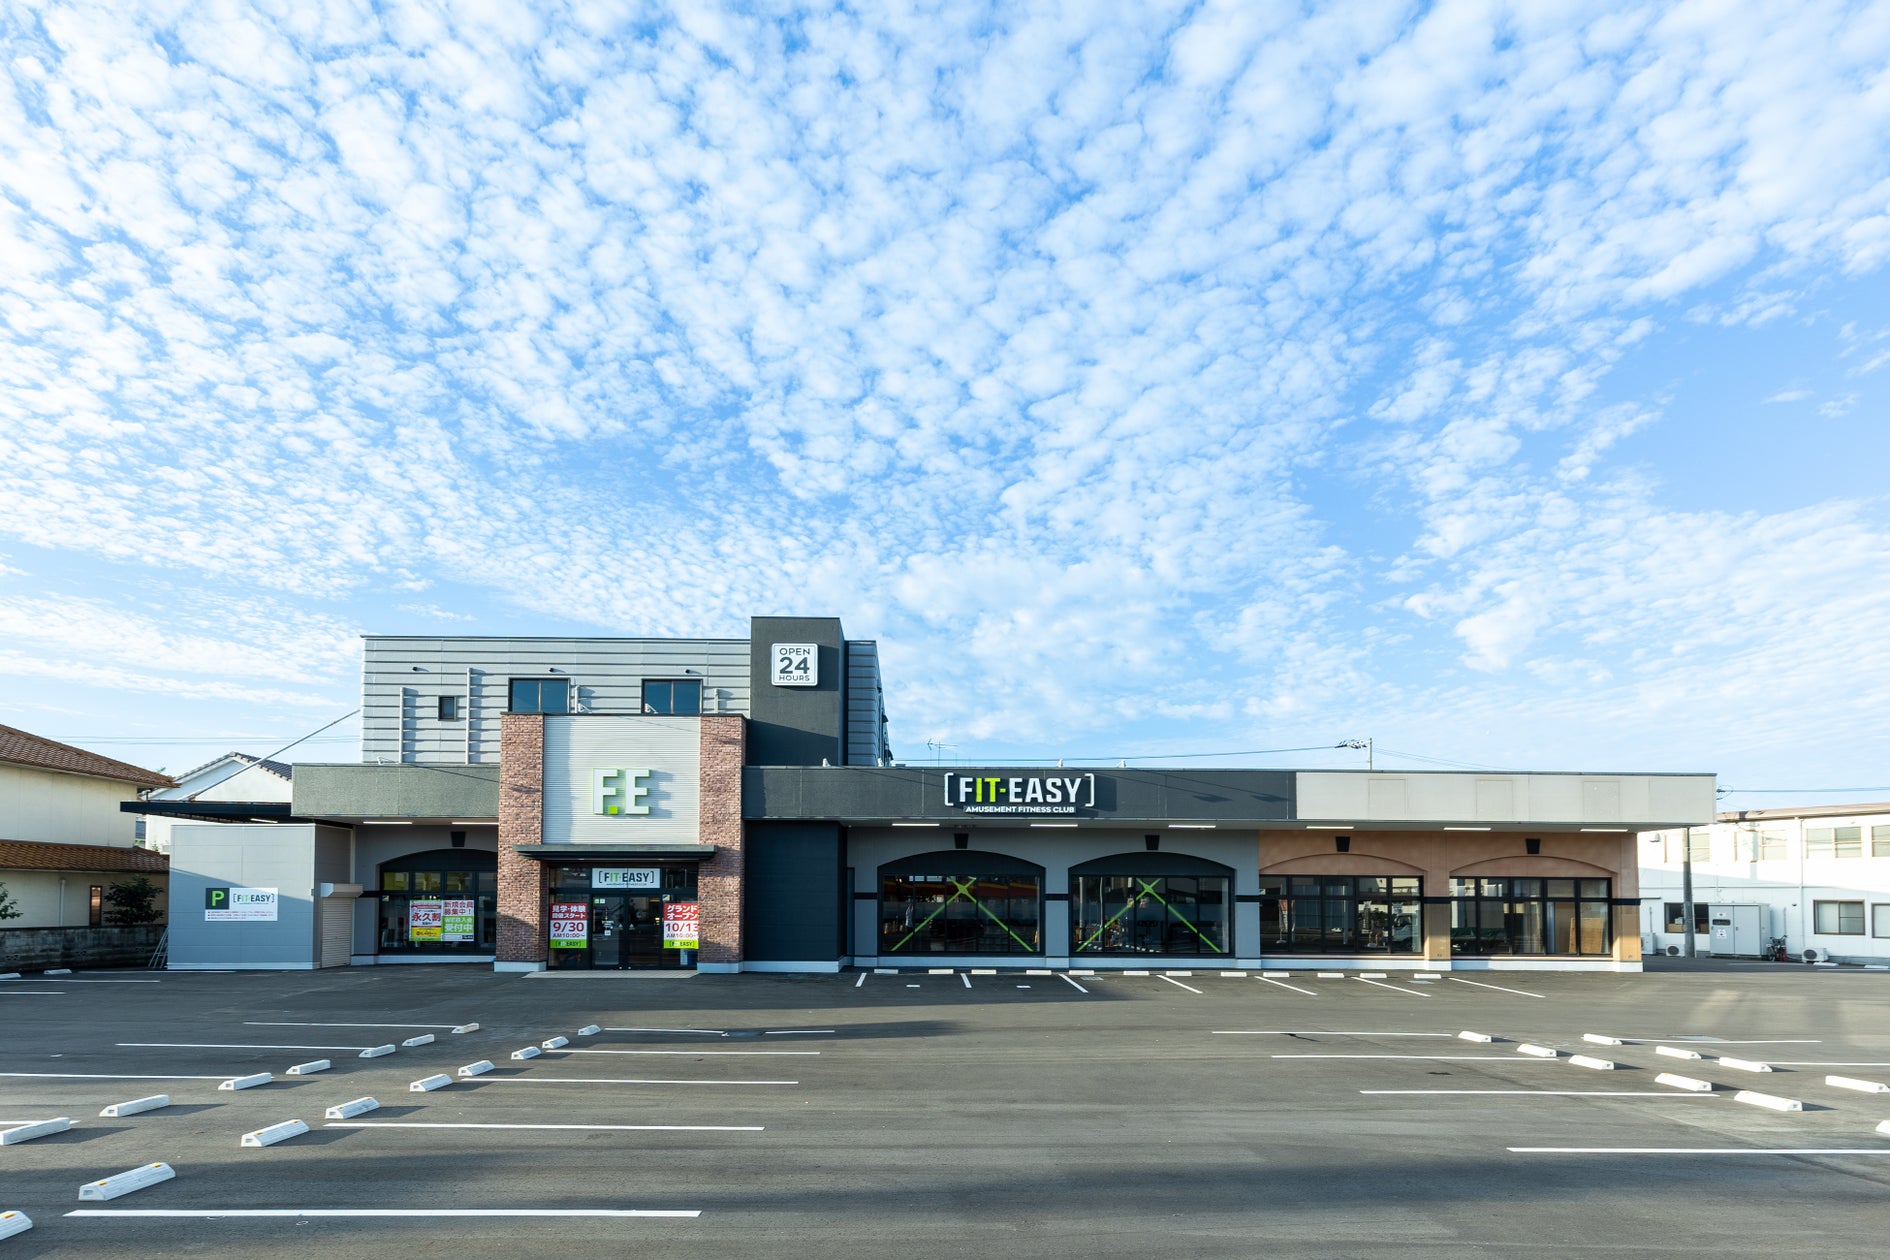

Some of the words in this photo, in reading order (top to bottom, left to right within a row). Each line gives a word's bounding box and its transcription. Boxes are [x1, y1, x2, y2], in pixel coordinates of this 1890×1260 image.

[779, 648, 810, 656] OPEN
[780, 656, 810, 674] 24
[212, 890, 224, 906] P
[412, 912, 442, 921] 永久割
[444, 924, 473, 932] 受付中
[553, 922, 584, 932] 9/30
[666, 922, 700, 932] 10/13
